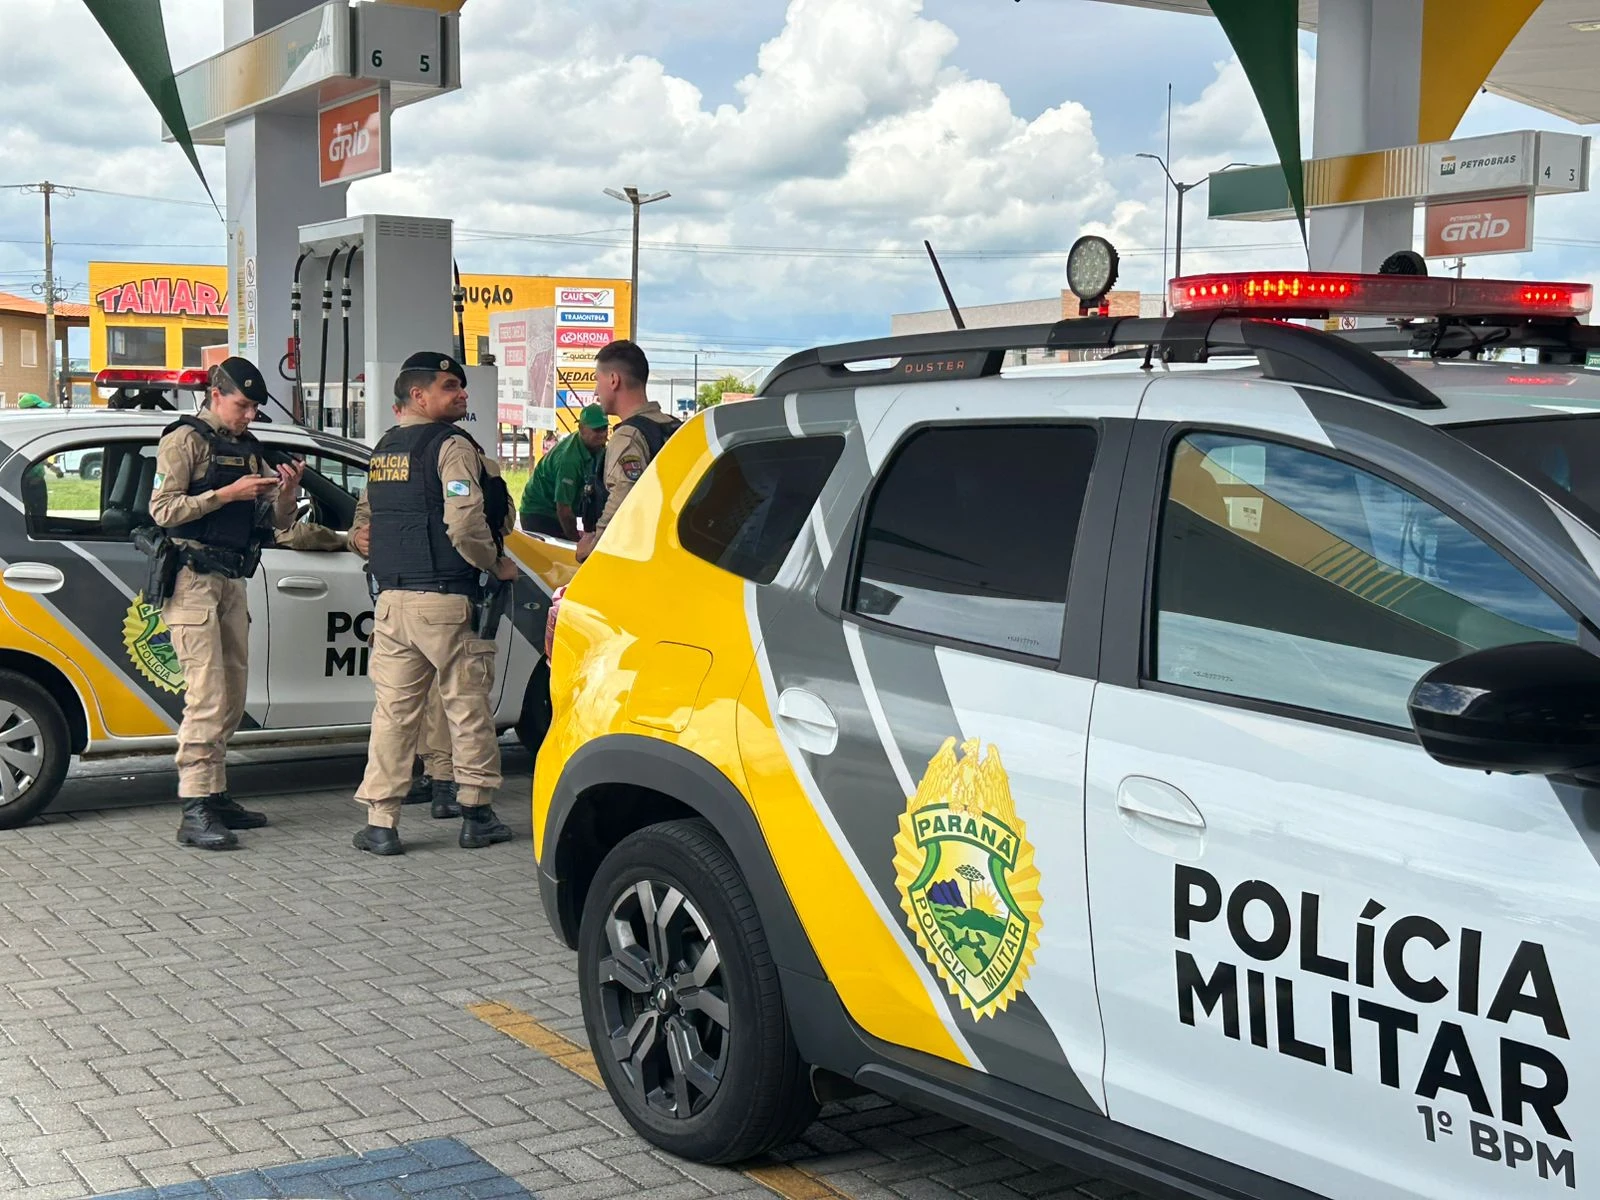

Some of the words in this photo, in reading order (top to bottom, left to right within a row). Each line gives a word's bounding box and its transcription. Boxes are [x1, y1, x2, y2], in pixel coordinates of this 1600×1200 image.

[371, 49, 383, 67] 6
[419, 55, 430, 72] 5
[328, 120, 370, 162] GRID
[1459, 154, 1517, 169] PETROBRAS
[1544, 166, 1552, 179] 4
[1568, 168, 1576, 182] 3
[1440, 213, 1511, 242] GRID
[96, 278, 229, 317] TAMAR
[564, 313, 606, 321] TRAMONTINA
[576, 332, 610, 342] KRONA
[904, 360, 966, 373] DUSTER
[369, 453, 410, 468] POLÍCIA
[368, 468, 410, 482] MILITAR
[916, 813, 1014, 860] PARANÁ
[982, 921, 1023, 993] MILITAR
[1174, 863, 1571, 1041] POLÍCIA
[1174, 949, 1573, 1142] MILITAR
[1469, 1119, 1577, 1190] BPM
